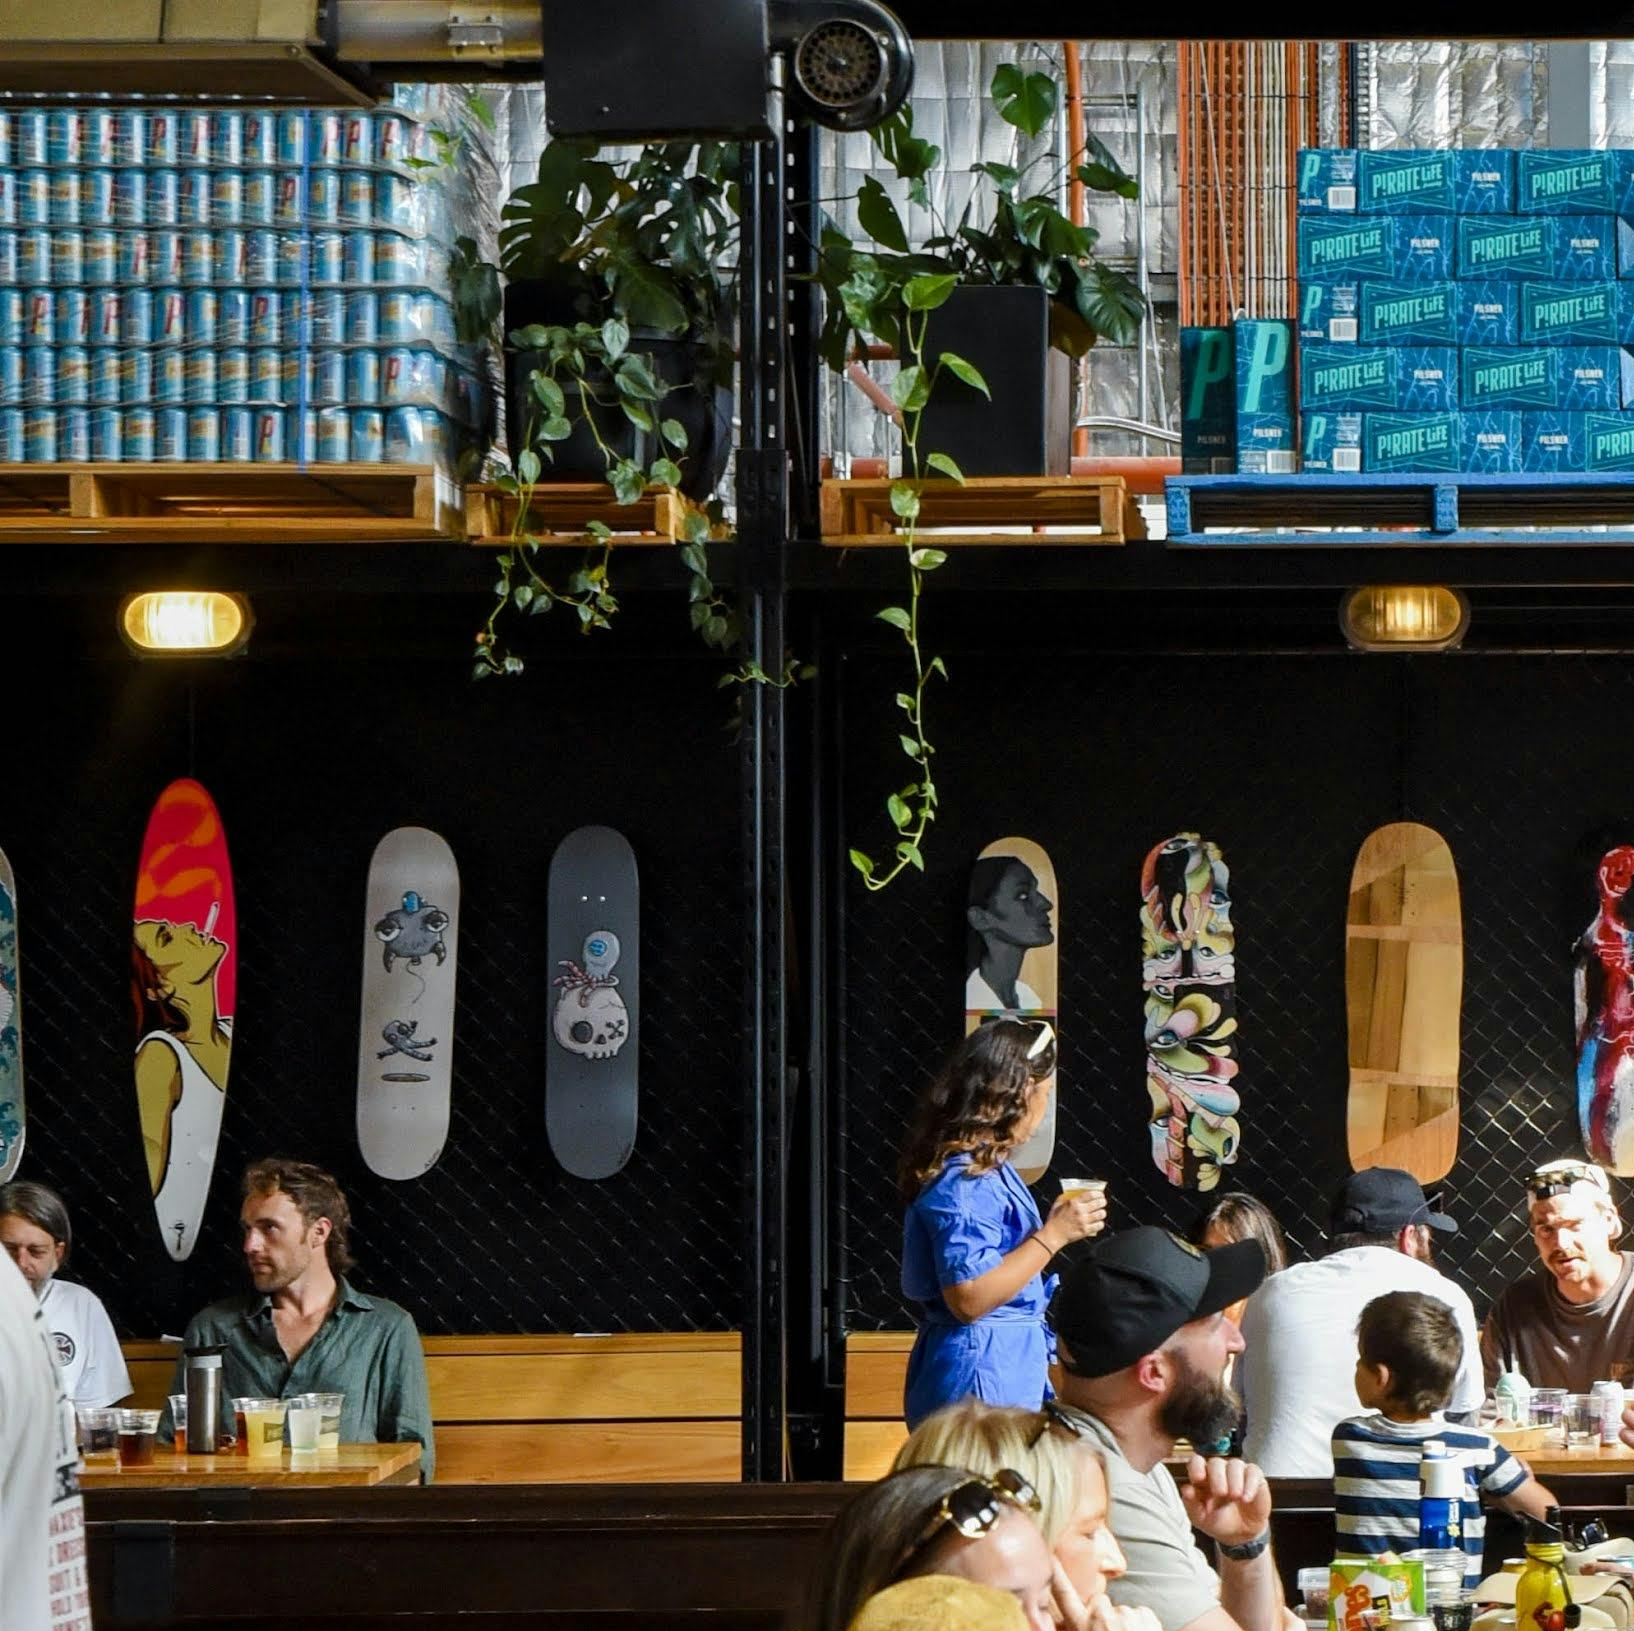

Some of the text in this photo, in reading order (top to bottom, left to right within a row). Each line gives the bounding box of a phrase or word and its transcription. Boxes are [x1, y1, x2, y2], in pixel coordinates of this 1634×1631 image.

[1301, 154, 1321, 193] P
[1303, 285, 1323, 325] P
[1187, 330, 1230, 420] P
[1244, 322, 1290, 412] P
[1306, 416, 1326, 455] P
